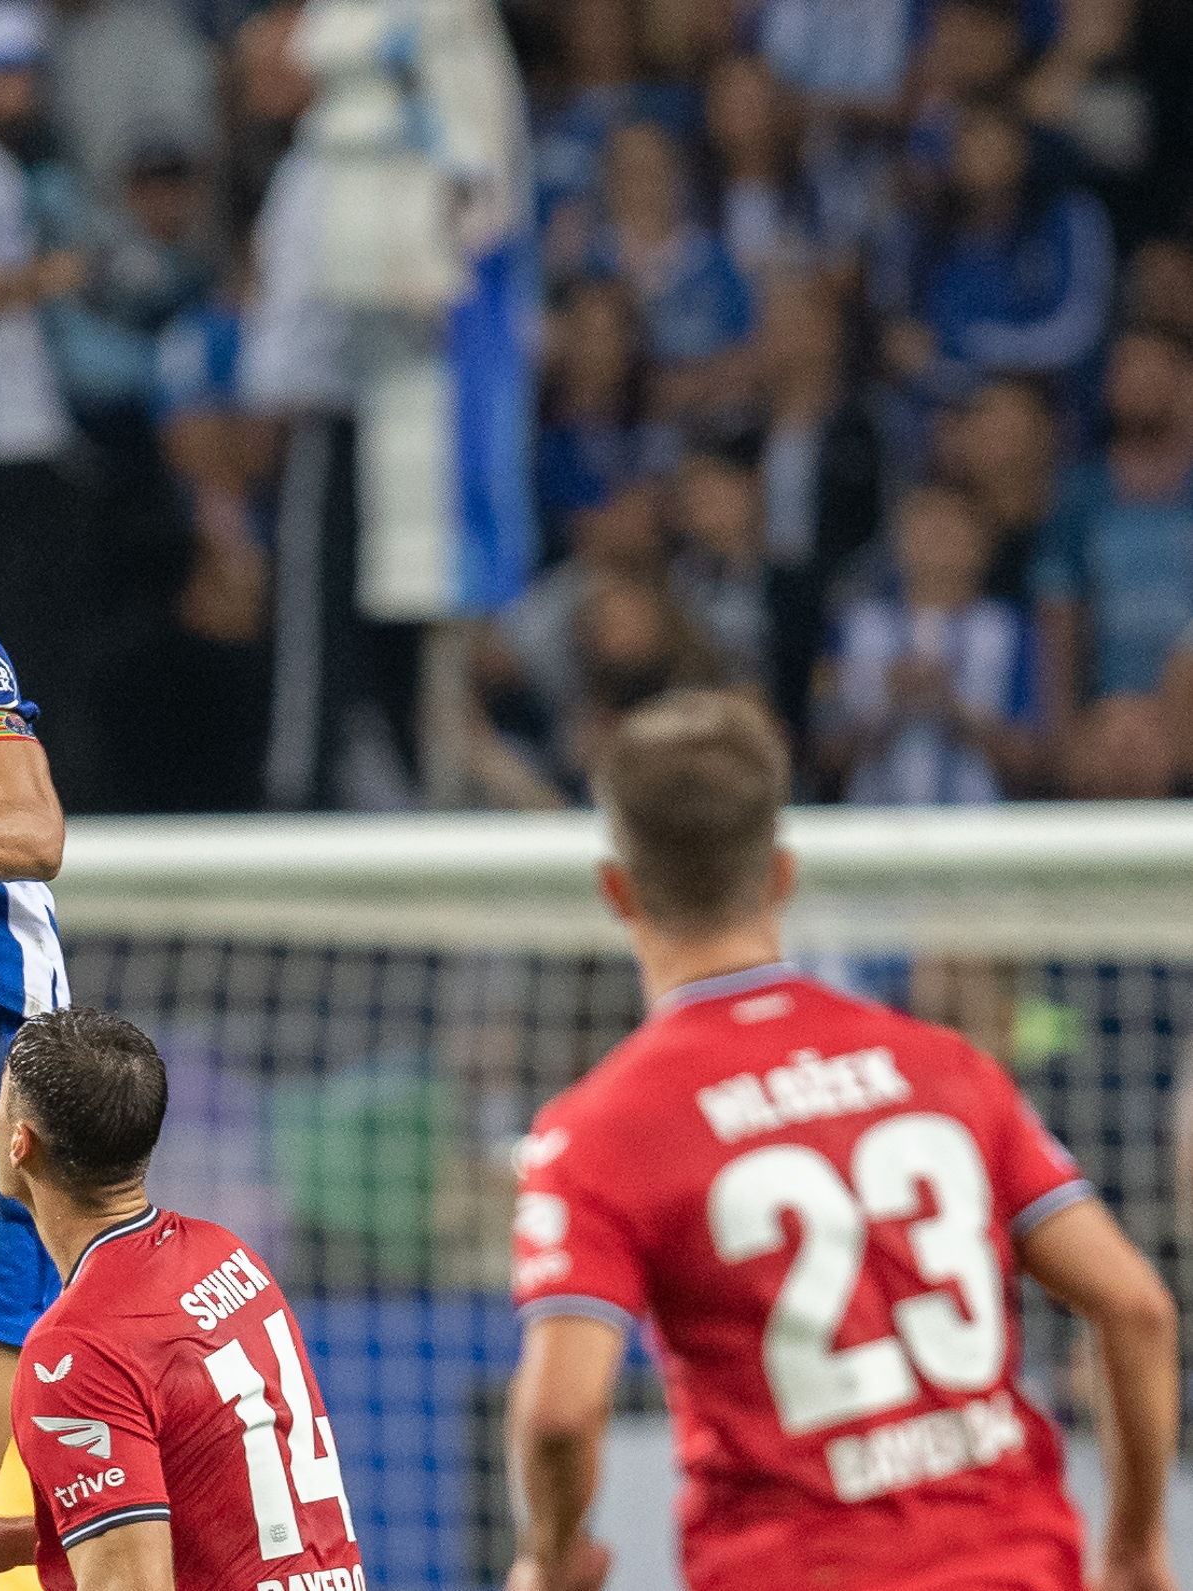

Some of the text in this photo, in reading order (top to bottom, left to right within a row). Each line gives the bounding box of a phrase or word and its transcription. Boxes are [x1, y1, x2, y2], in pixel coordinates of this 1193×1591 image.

[179, 1248, 270, 1331] SCHICK
[708, 1113, 1009, 1436] 23
[54, 1466, 126, 1509] trive
[204, 1308, 357, 1561] 14
